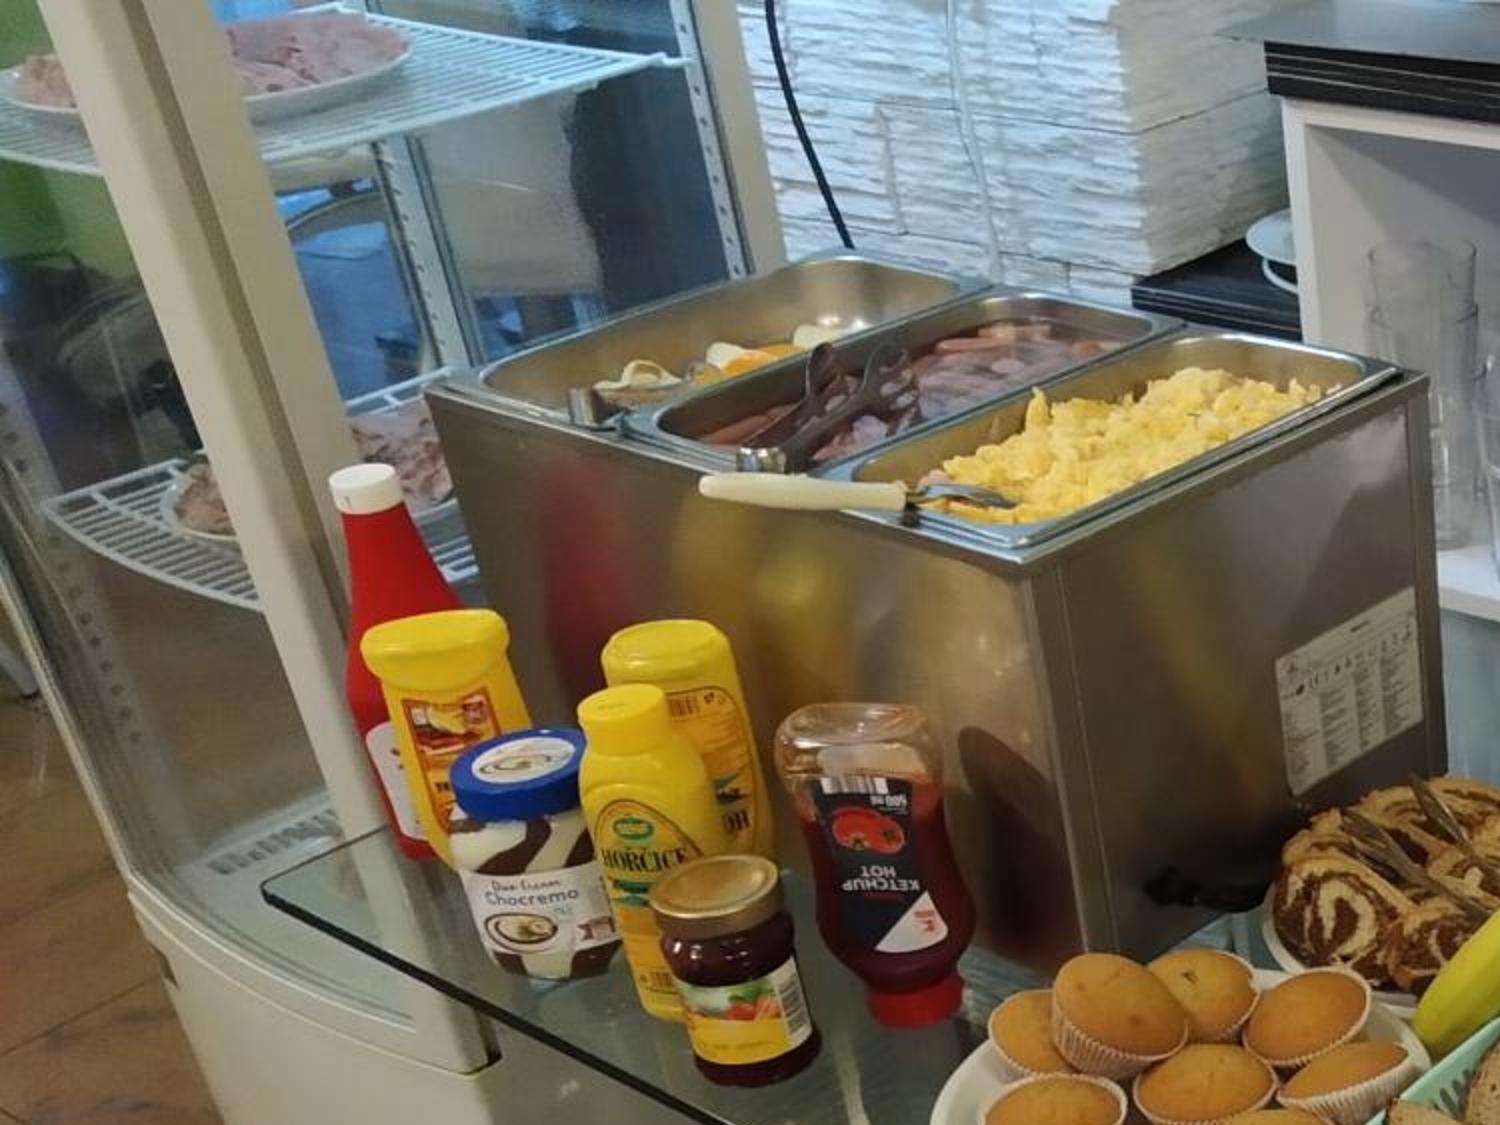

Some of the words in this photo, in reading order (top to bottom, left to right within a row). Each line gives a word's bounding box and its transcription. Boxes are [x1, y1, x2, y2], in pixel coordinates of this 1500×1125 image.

[862, 866, 896, 878] HOT
[843, 880, 920, 891] KETCHUP
[484, 888, 580, 907] Chocremo
